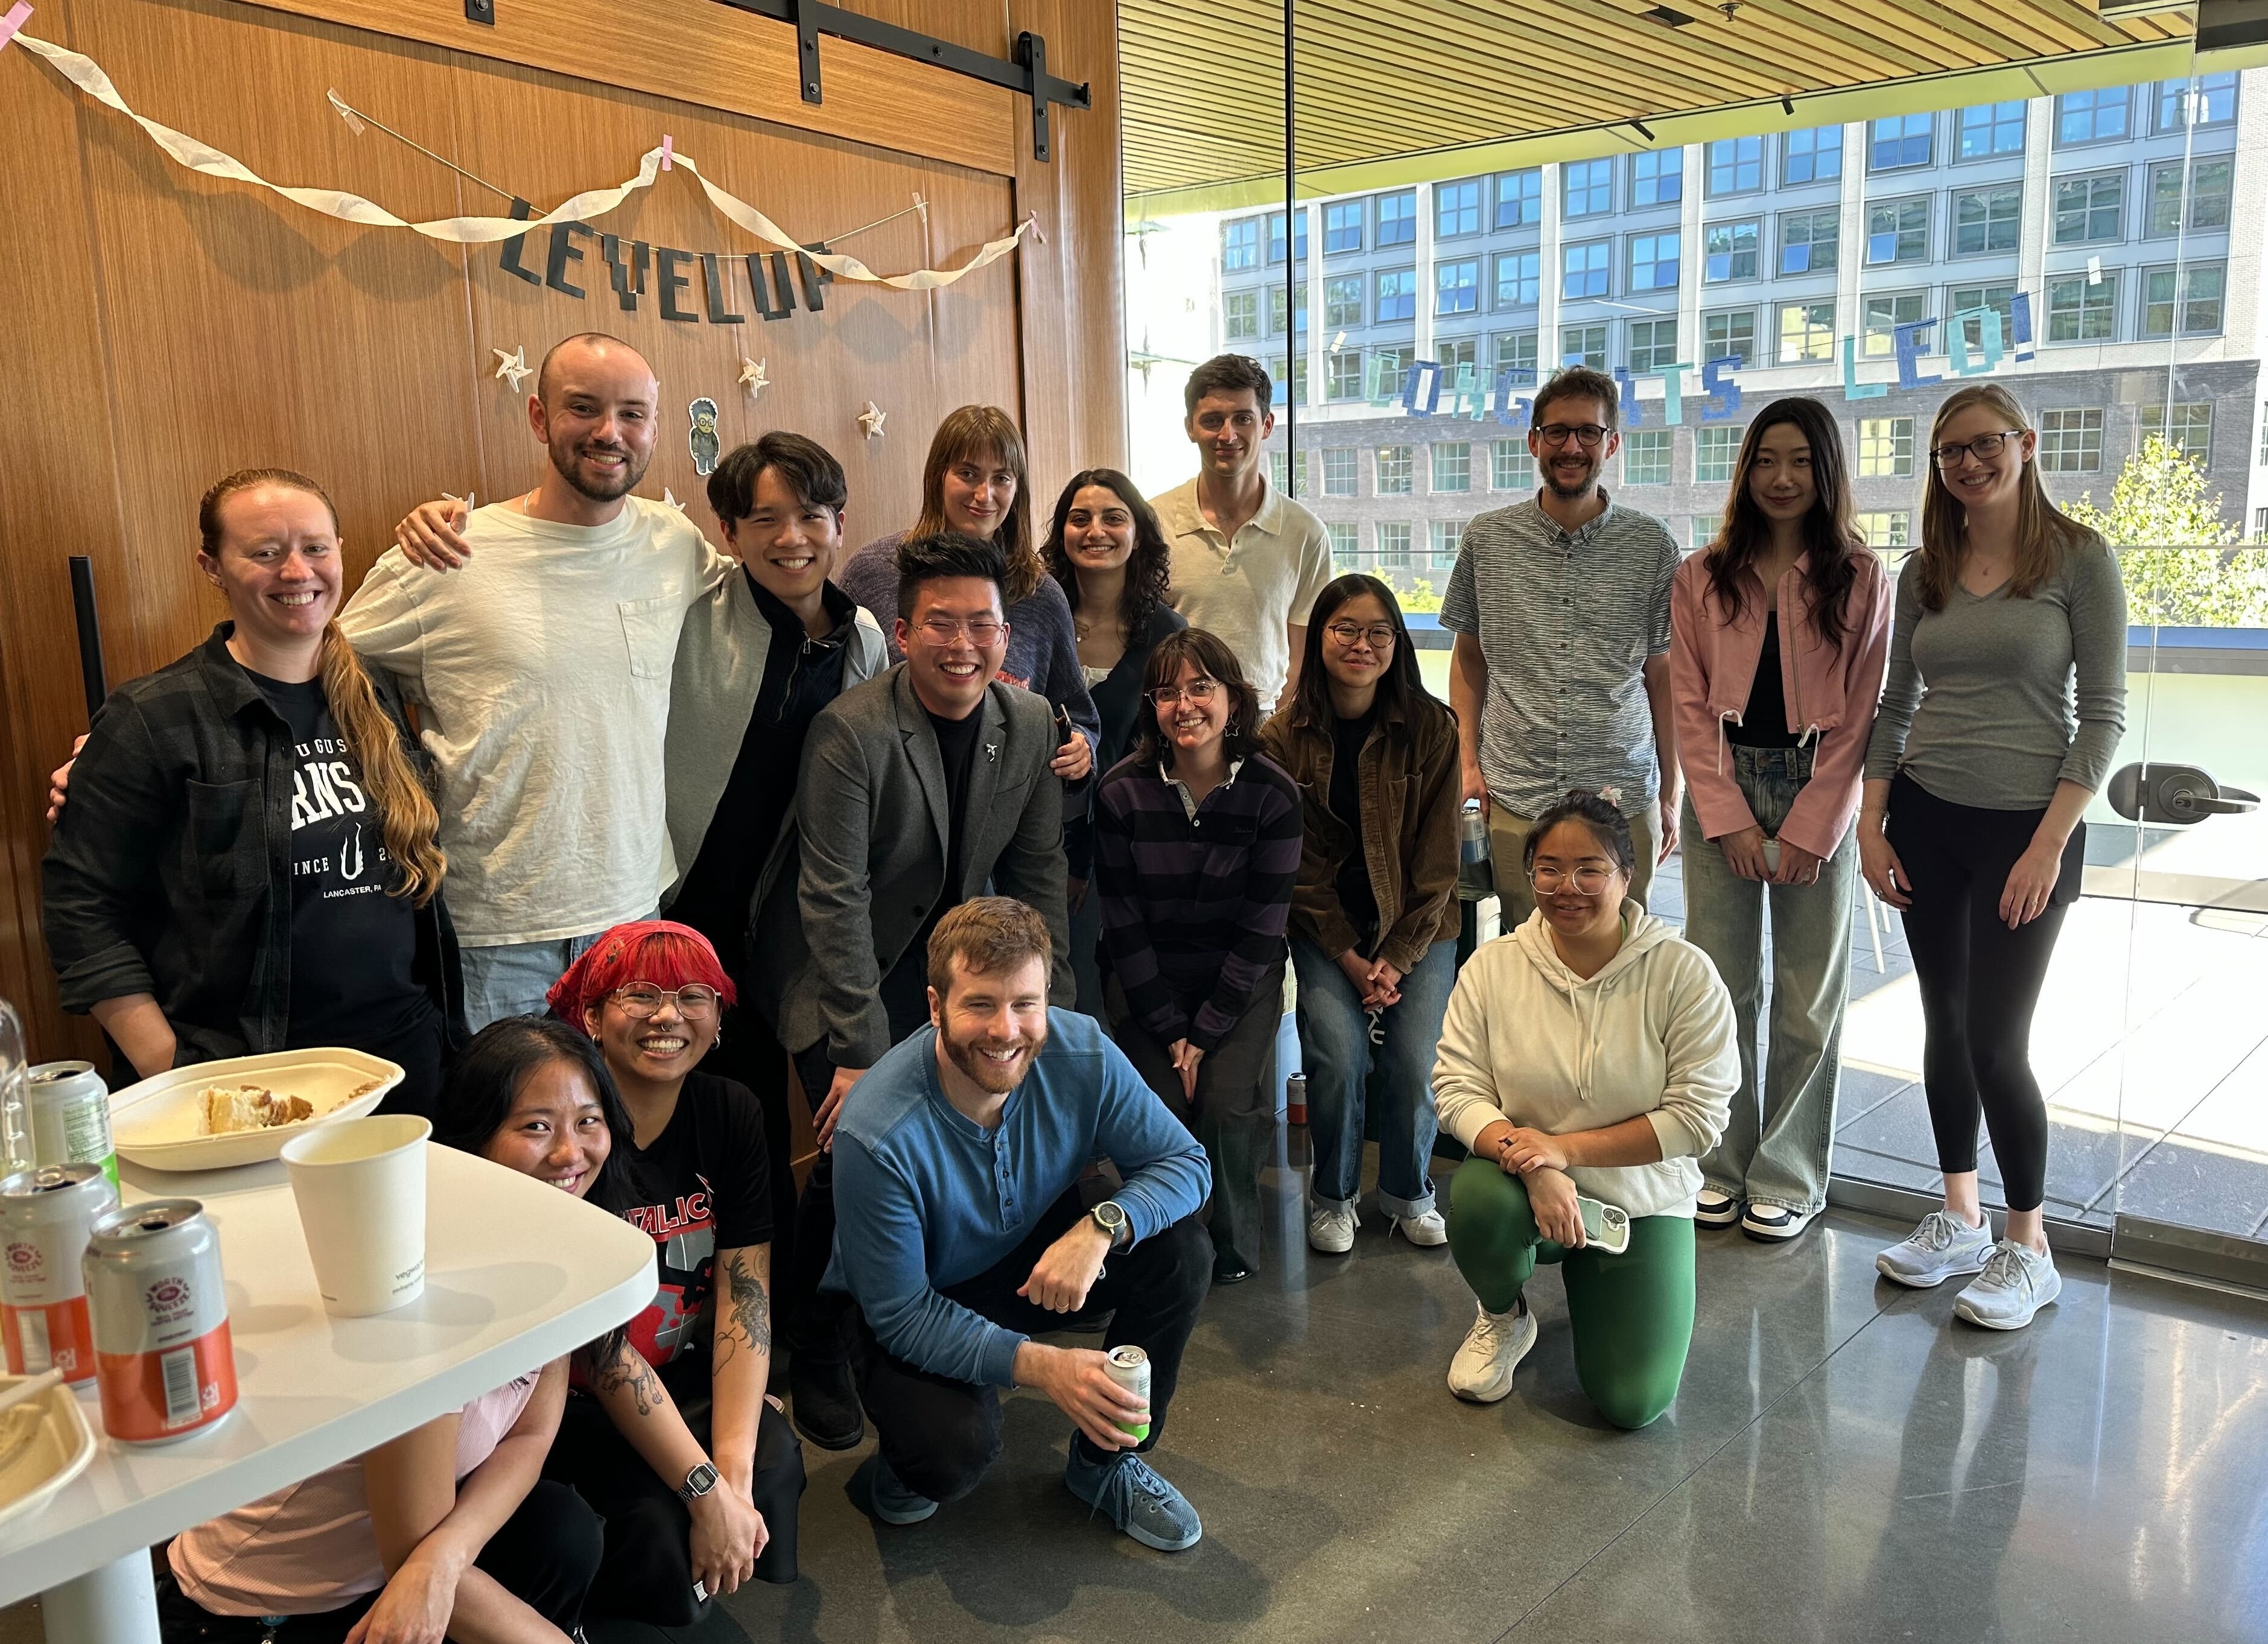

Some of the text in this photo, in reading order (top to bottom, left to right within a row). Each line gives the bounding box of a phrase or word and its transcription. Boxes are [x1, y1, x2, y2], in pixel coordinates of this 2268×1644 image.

[1365, 291, 2035, 427] CONGTS LEO!
[295, 738, 347, 757] UGUS
[291, 761, 366, 831] RNS
[294, 857, 329, 875] INCE
[323, 886, 373, 898] LANCASTER,
